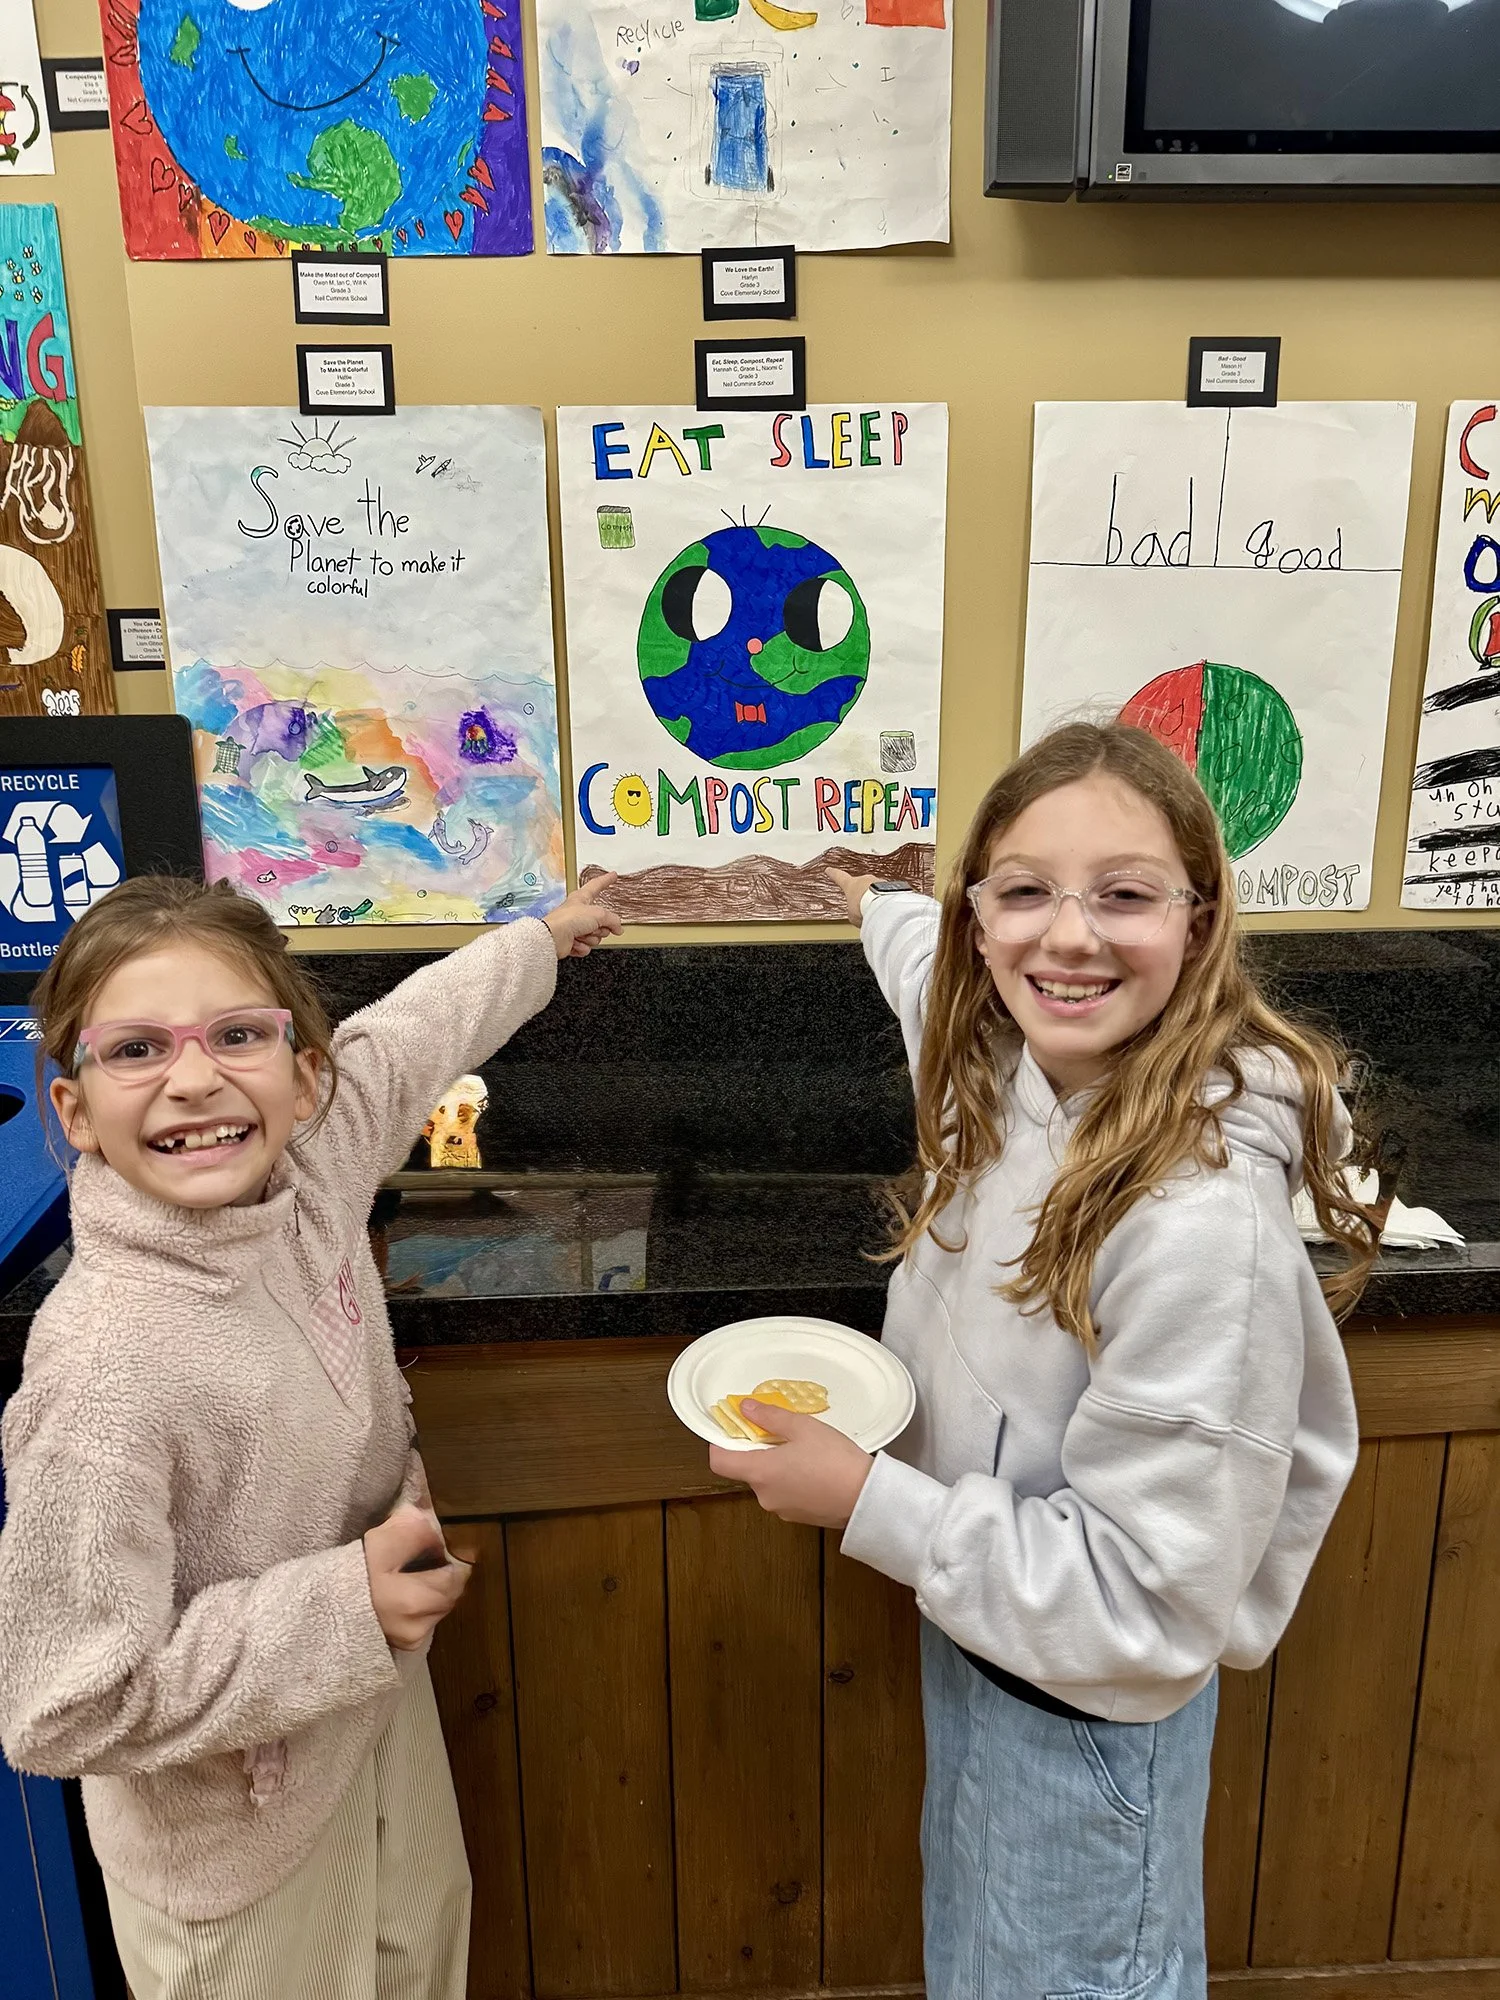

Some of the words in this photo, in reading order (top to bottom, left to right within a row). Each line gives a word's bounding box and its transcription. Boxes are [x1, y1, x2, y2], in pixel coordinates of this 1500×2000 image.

[592, 422, 725, 481] EAT
[770, 411, 908, 469] SLEEP
[238, 465, 344, 540] Save
[357, 478, 410, 538] the
[1105, 474, 1193, 566] bad
[1246, 520, 1341, 573] good
[290, 538, 361, 574] Planet
[370, 550, 393, 575] to
[402, 551, 446, 573] make
[450, 549, 466, 572] it
[307, 575, 368, 598] colorful
[0, 774, 80, 792] RECYCLE
[578, 762, 801, 837] COMPOST
[814, 777, 937, 833] REPEAT
[1238, 864, 1361, 907] OMPOST
[0, 941, 60, 958] Bottles
